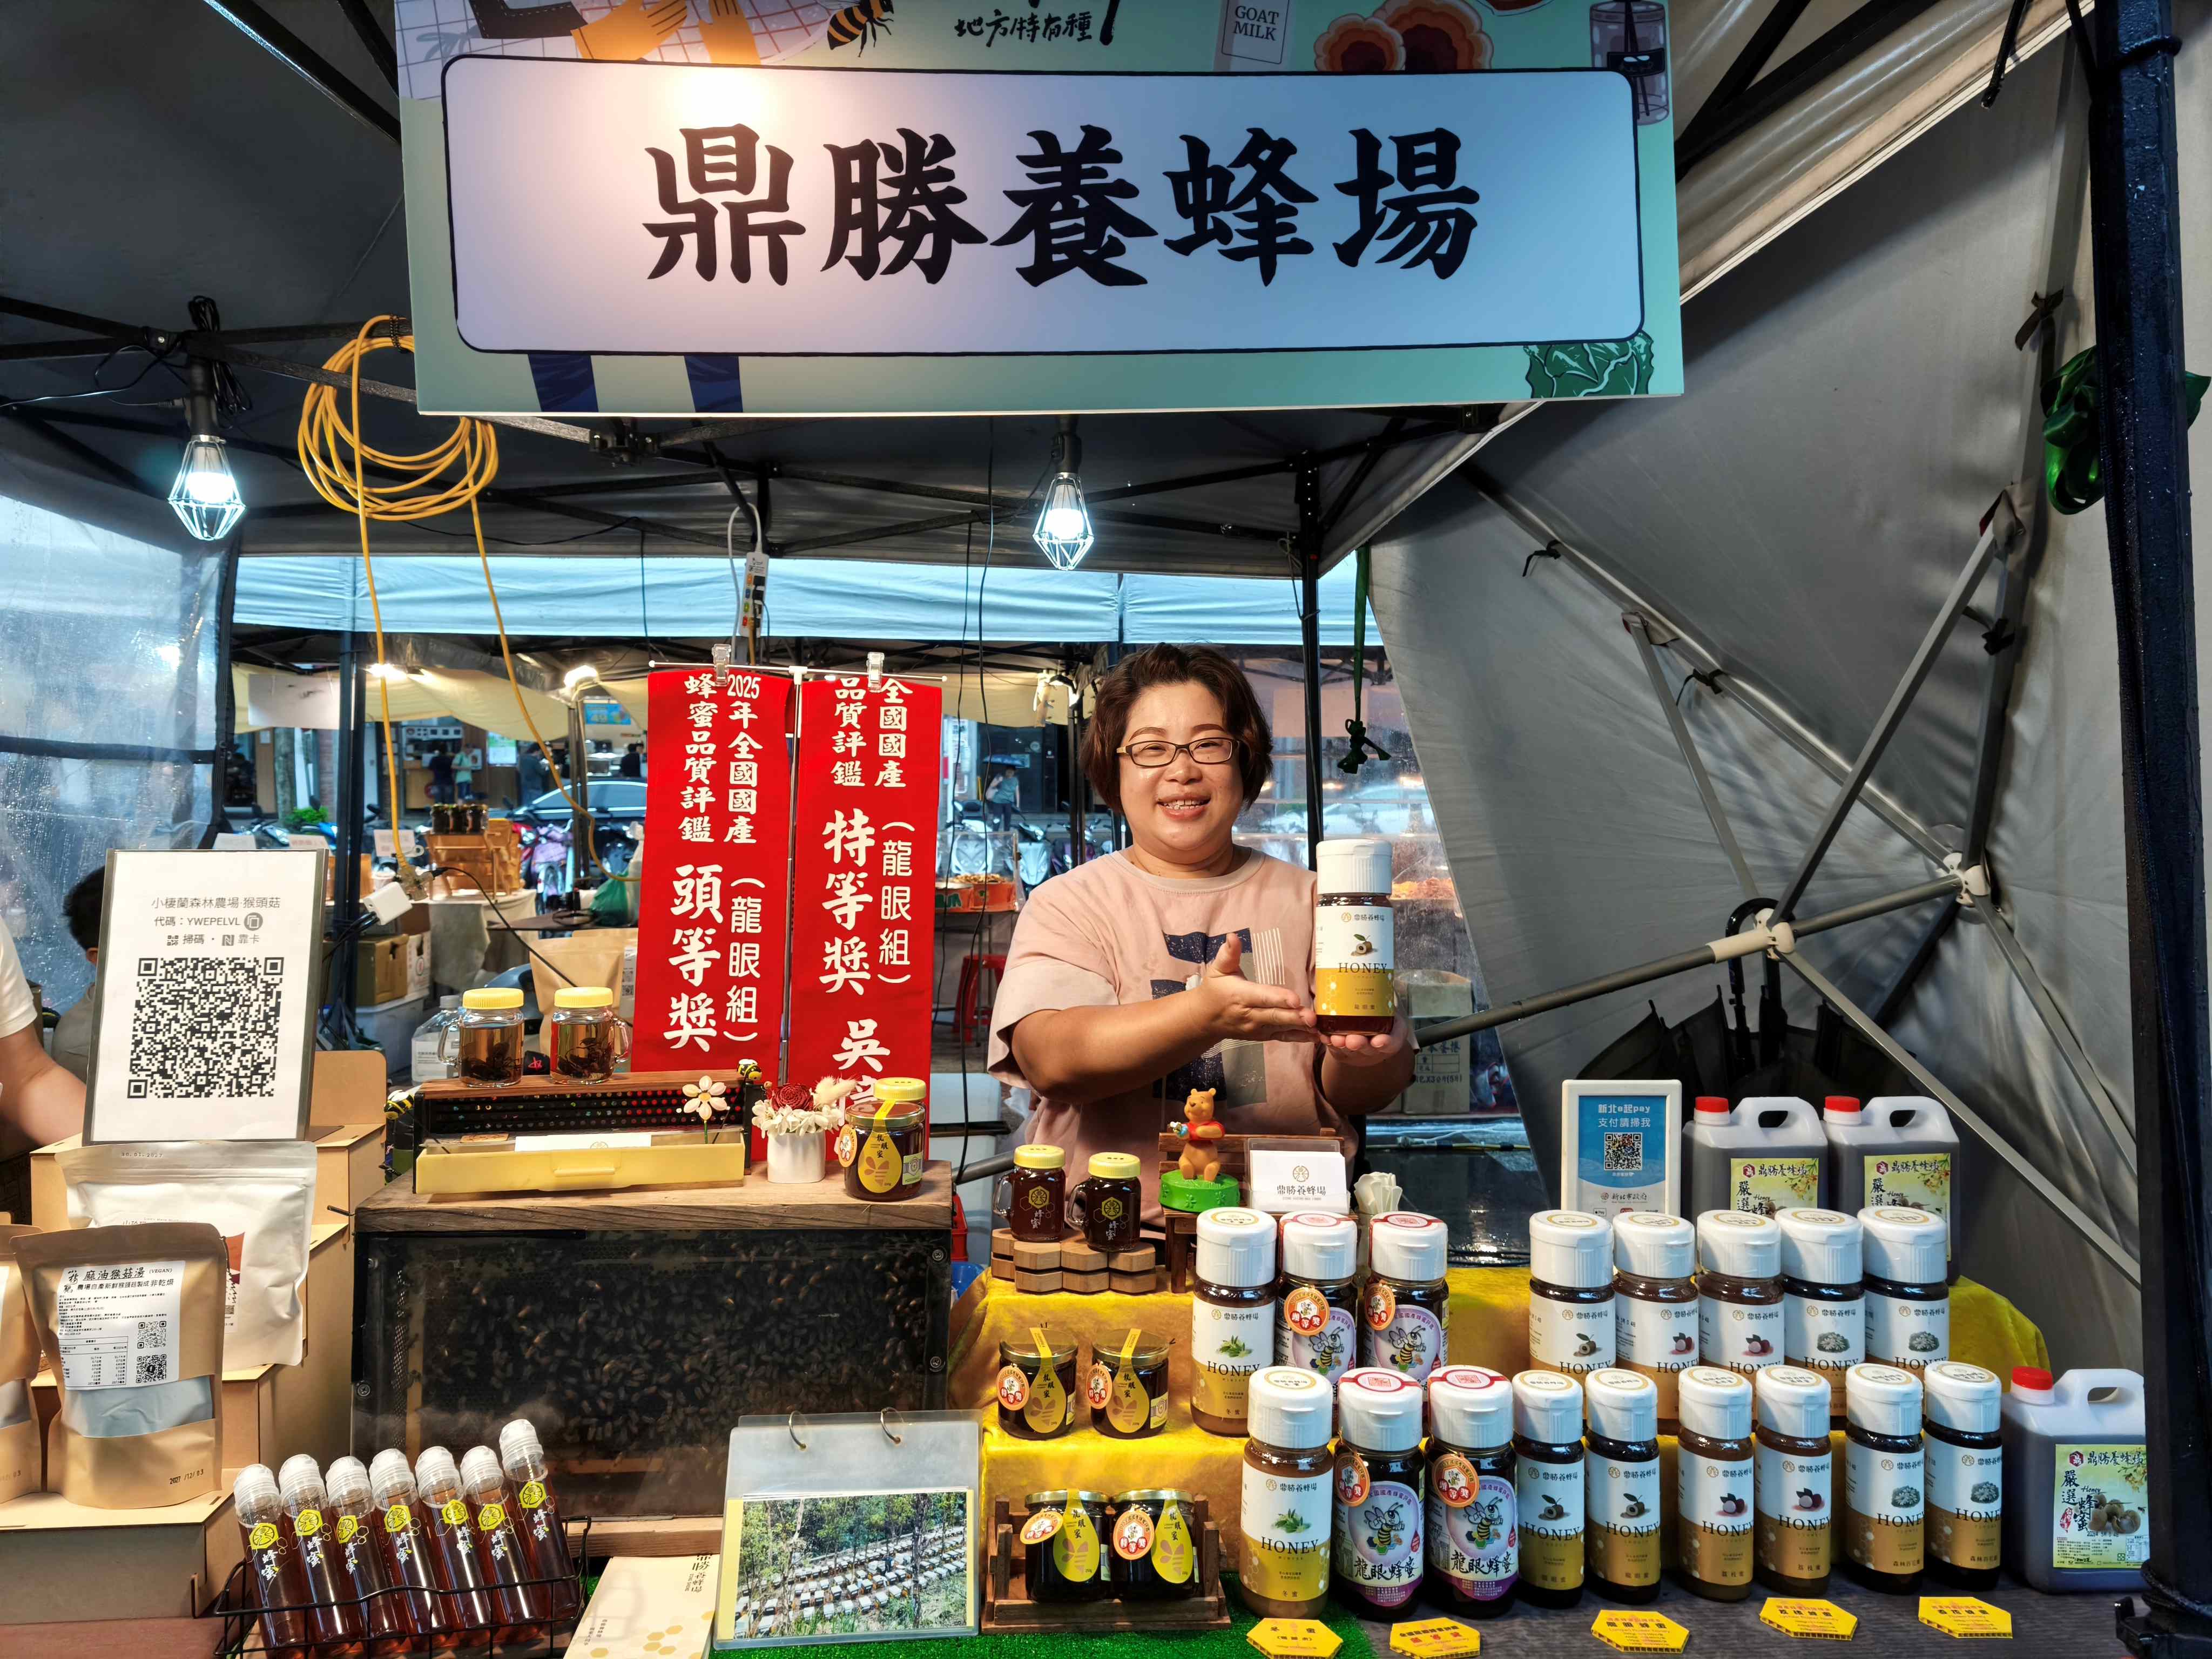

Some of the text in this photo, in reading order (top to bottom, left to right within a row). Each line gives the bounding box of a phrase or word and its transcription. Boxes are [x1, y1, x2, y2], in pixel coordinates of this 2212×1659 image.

[1235, 5, 1279, 25] GOAT
[954, 10, 1092, 47] 地方特有種
[1233, 22, 1277, 42] MILK
[642, 123, 1480, 287] 鼎勝養蜂場
[831, 677, 867, 787] 品質評鑑
[663, 675, 724, 1053] 蜂蜜品質評鑑 頭等獎
[819, 808, 875, 995] 特等獎
[183, 934, 259, 945] 掃碼 靠卡
[1338, 962, 1387, 974] HONEY
[1598, 1118, 1651, 1128] 支付請掃我
[1758, 1163, 1808, 1177] 鼎勝養蜂場
[1891, 1160, 1940, 1174] 鼎勝養蜂場
[1277, 1185, 1326, 1196] 鼎勝養蜂場
[83, 1266, 145, 1280] 麻油猴菇湯
[1207, 1360, 1261, 1377] HONEY
[2087, 1451, 2144, 1466] 鼎勝養蜂場
[1280, 1483, 1318, 1492] 鼎勝養蜂場
[2061, 1469, 2080, 1506] 嚴選
[2081, 1485, 2102, 1494] Honey
[2073, 1494, 2098, 1531] 蜂蜜
[1525, 1521, 1580, 1541] HONEY
[1606, 1520, 1659, 1538] HONEY
[1261, 1536, 1319, 1555] HONEY
[1353, 1556, 1418, 1582] 龍眼蜂蜜
[1451, 1551, 1515, 1579] 龍眼蜂蜜
